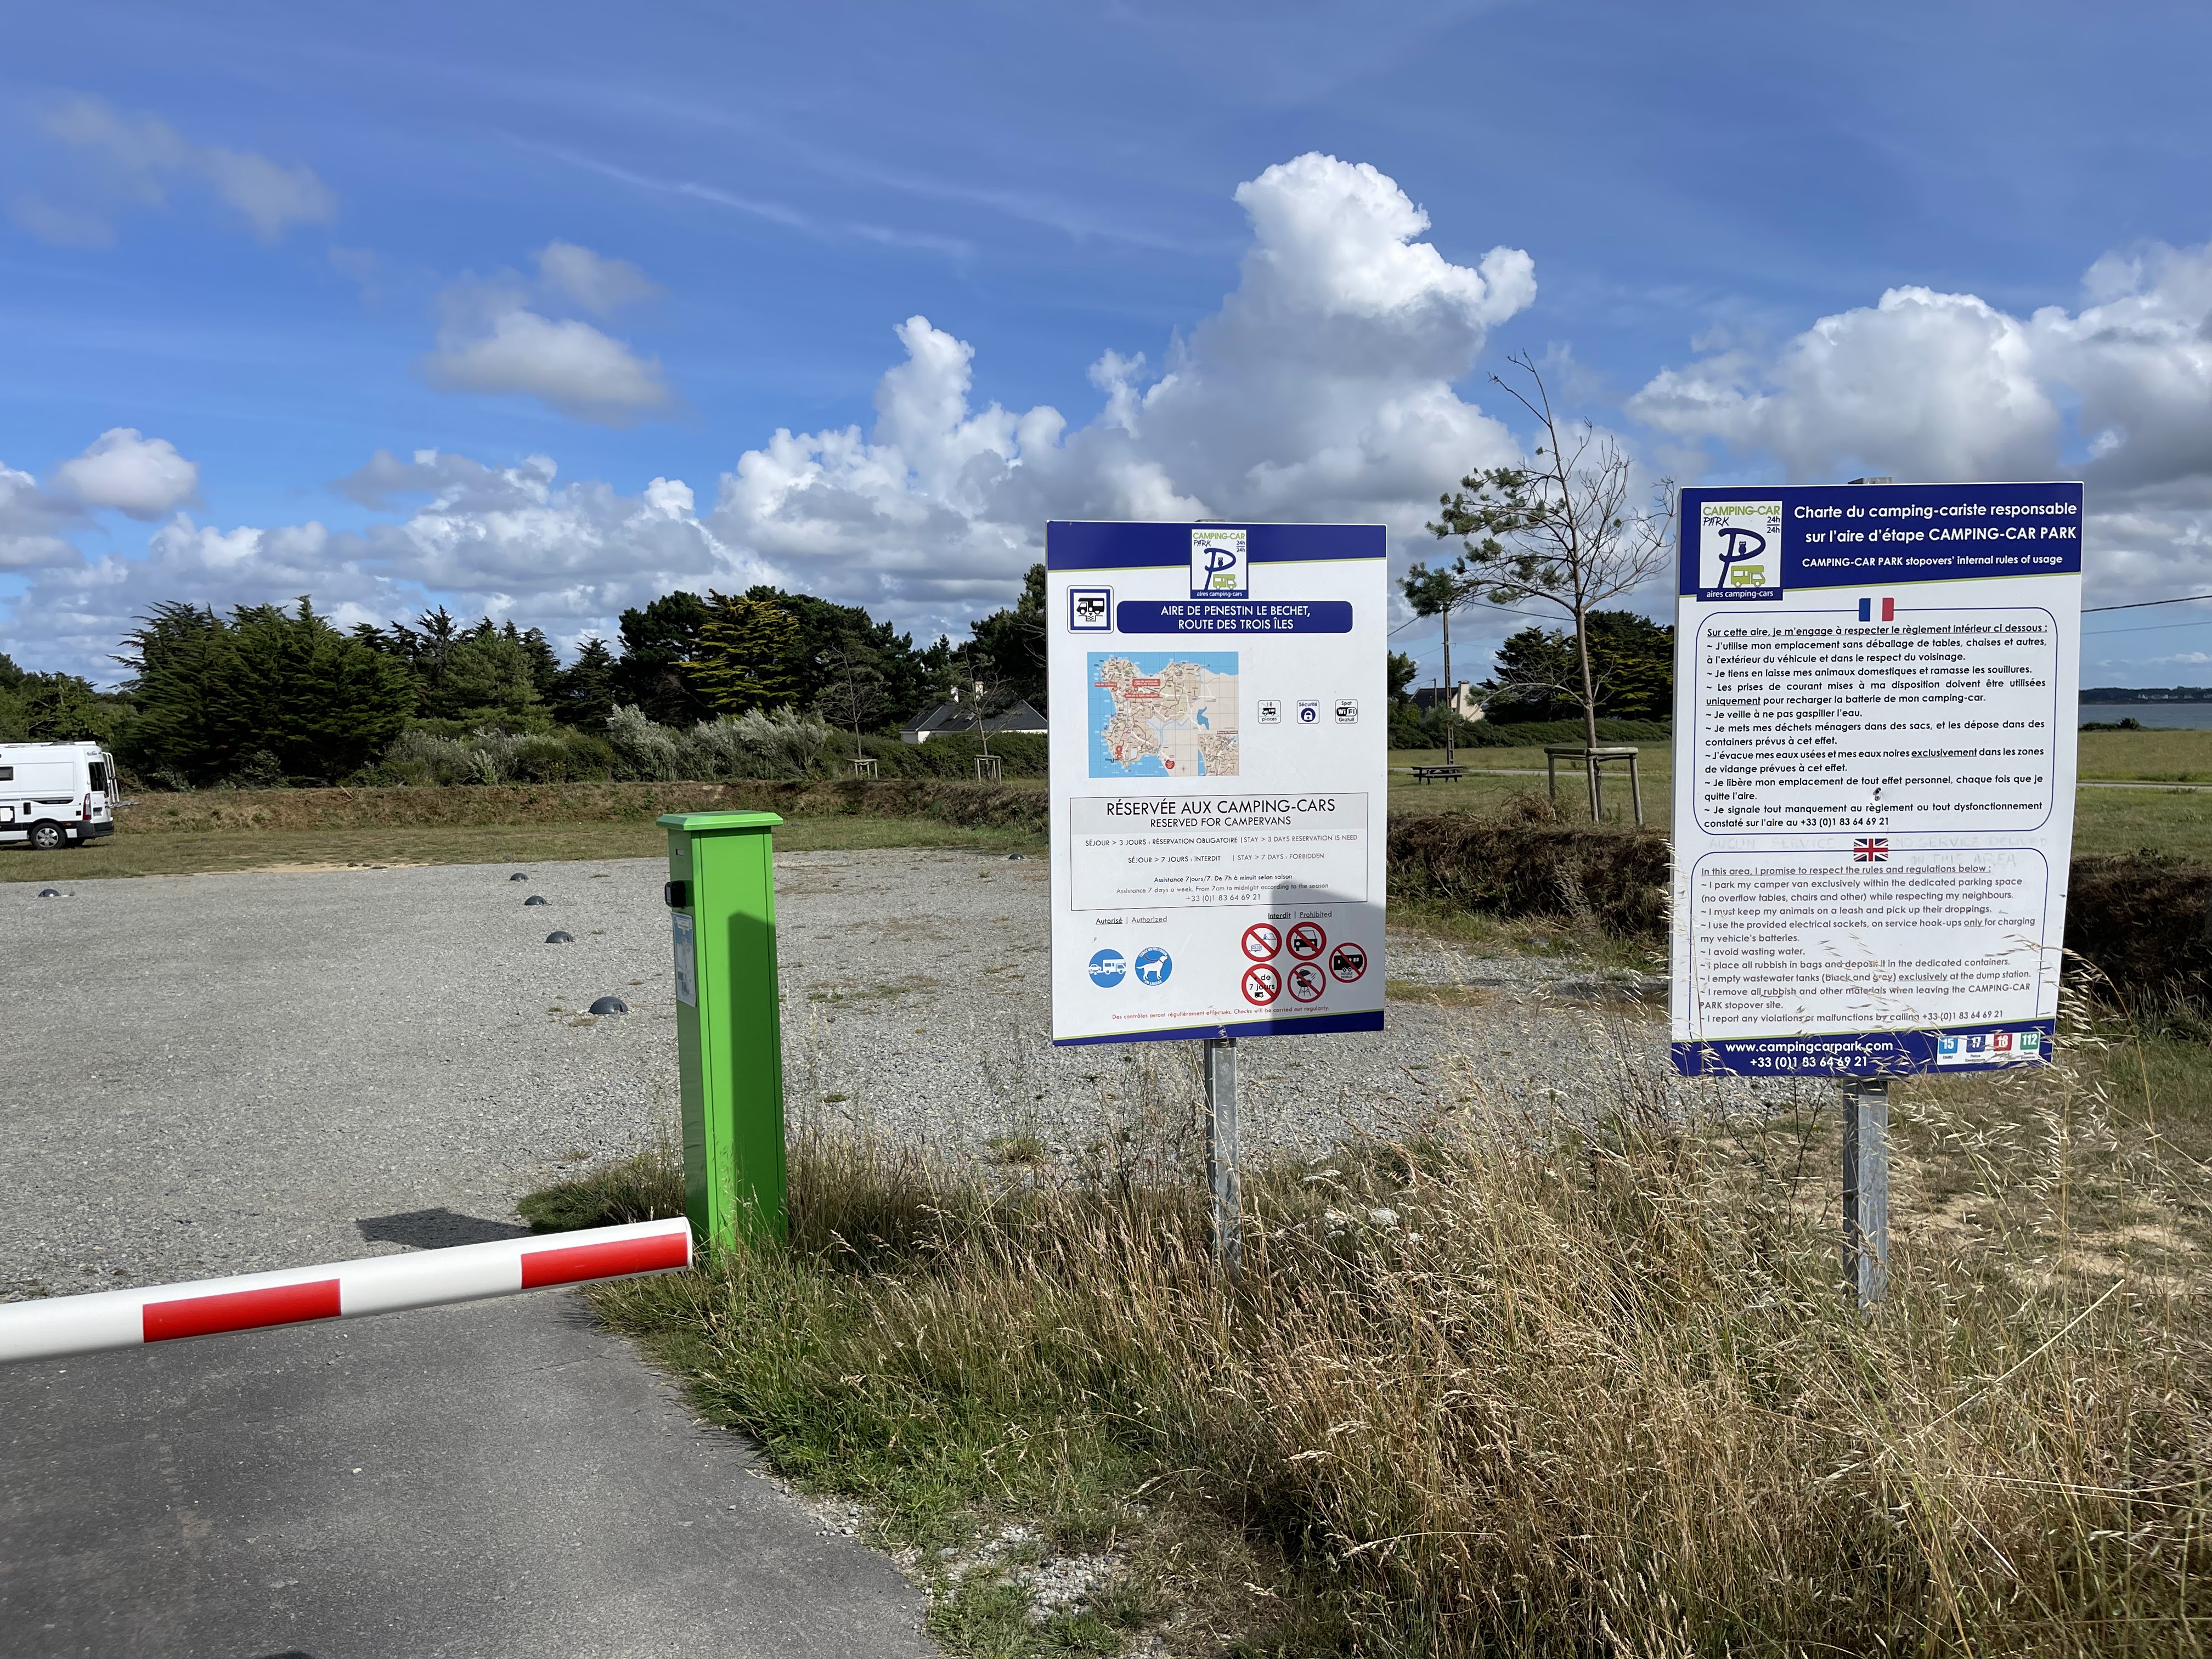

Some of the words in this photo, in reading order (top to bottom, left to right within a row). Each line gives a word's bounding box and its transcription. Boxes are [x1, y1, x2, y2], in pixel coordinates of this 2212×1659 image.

[1703, 505, 1780, 516] CAMPING-CAR
[1794, 505, 1842, 518] Charte
[1846, 505, 1864, 517] du
[1869, 503, 1987, 520] camping-cariste
[1990, 502, 2077, 518] responsable
[1703, 516, 1730, 527] PARK
[1805, 533, 1826, 543] sur
[1829, 529, 1864, 542] l'aire
[1868, 527, 1925, 544] d'étape
[1928, 527, 2036, 540] CAMPING-CAR
[2040, 526, 2076, 539] PARK
[1802, 557, 1875, 567] CAMPING-CAR
[1878, 557, 1903, 566] PARK
[1905, 556, 1955, 567] stopovers'
[1957, 555, 1993, 565] internal
[1995, 555, 2018, 564] rules
[2021, 554, 2030, 563] of
[2033, 556, 2063, 565] usage
[1724, 590, 1774, 599] camping-cars
[1160, 605, 1183, 616] AIRE
[1187, 605, 1200, 616] DE
[1204, 605, 1253, 616] PENESTIN
[1257, 605, 1267, 616] LE
[1271, 605, 1310, 617] BECHET,
[1178, 619, 1214, 629] ROUTE
[1217, 619, 1237, 629] DES
[1239, 619, 1271, 629] TROIS
[1274, 617, 1294, 629] ÎLES
[1707, 628, 1721, 637] Sur
[1723, 628, 1747, 637] cette
[1750, 628, 1770, 637] aire,
[1773, 627, 1782, 637] je
[1784, 627, 1833, 637] m'engage
[1835, 625, 1842, 636] à
[1844, 625, 1889, 636] respecter
[1891, 625, 1900, 635] le
[1902, 624, 1951, 635] règlement
[1953, 623, 1991, 634] intérieur
[1993, 624, 2002, 633] ci
[2005, 624, 2042, 633] dessous
[1705, 792, 1730, 802] quitte
[1733, 792, 1757, 800] l'aire.
[1107, 798, 1176, 815] RÉSERVÉE
[1181, 800, 1211, 814] AUX
[1217, 798, 1335, 814] CAMPING-CARS
[1150, 818, 1198, 827] RESERVED
[1201, 817, 1221, 826] FOR
[1224, 816, 1291, 826] CAMPERVANS
[1096, 917, 1122, 925] Autorisé
[1131, 915, 1167, 924] Authorized
[1299, 910, 1332, 918] Prohibited
[1759, 933, 1799, 942] batteries.
[1713, 947, 1739, 956] avoid
[1741, 947, 1775, 957] wasting
[1725, 1041, 1893, 1054] www.campingcarparkcom
[1943, 1038, 1954, 1049] 15
[1972, 1036, 1982, 1048] 17
[1997, 1035, 2008, 1048] 18
[2022, 1034, 2037, 1046] 112
[1750, 1057, 1772, 1068] +33
[1775, 1057, 1797, 1069] (0)1
[1802, 1057, 1816, 1067] 83
[1819, 1056, 1833, 1067] 64
[1837, 1056, 1850, 1067] 69
[1854, 1056, 1867, 1066] 21
